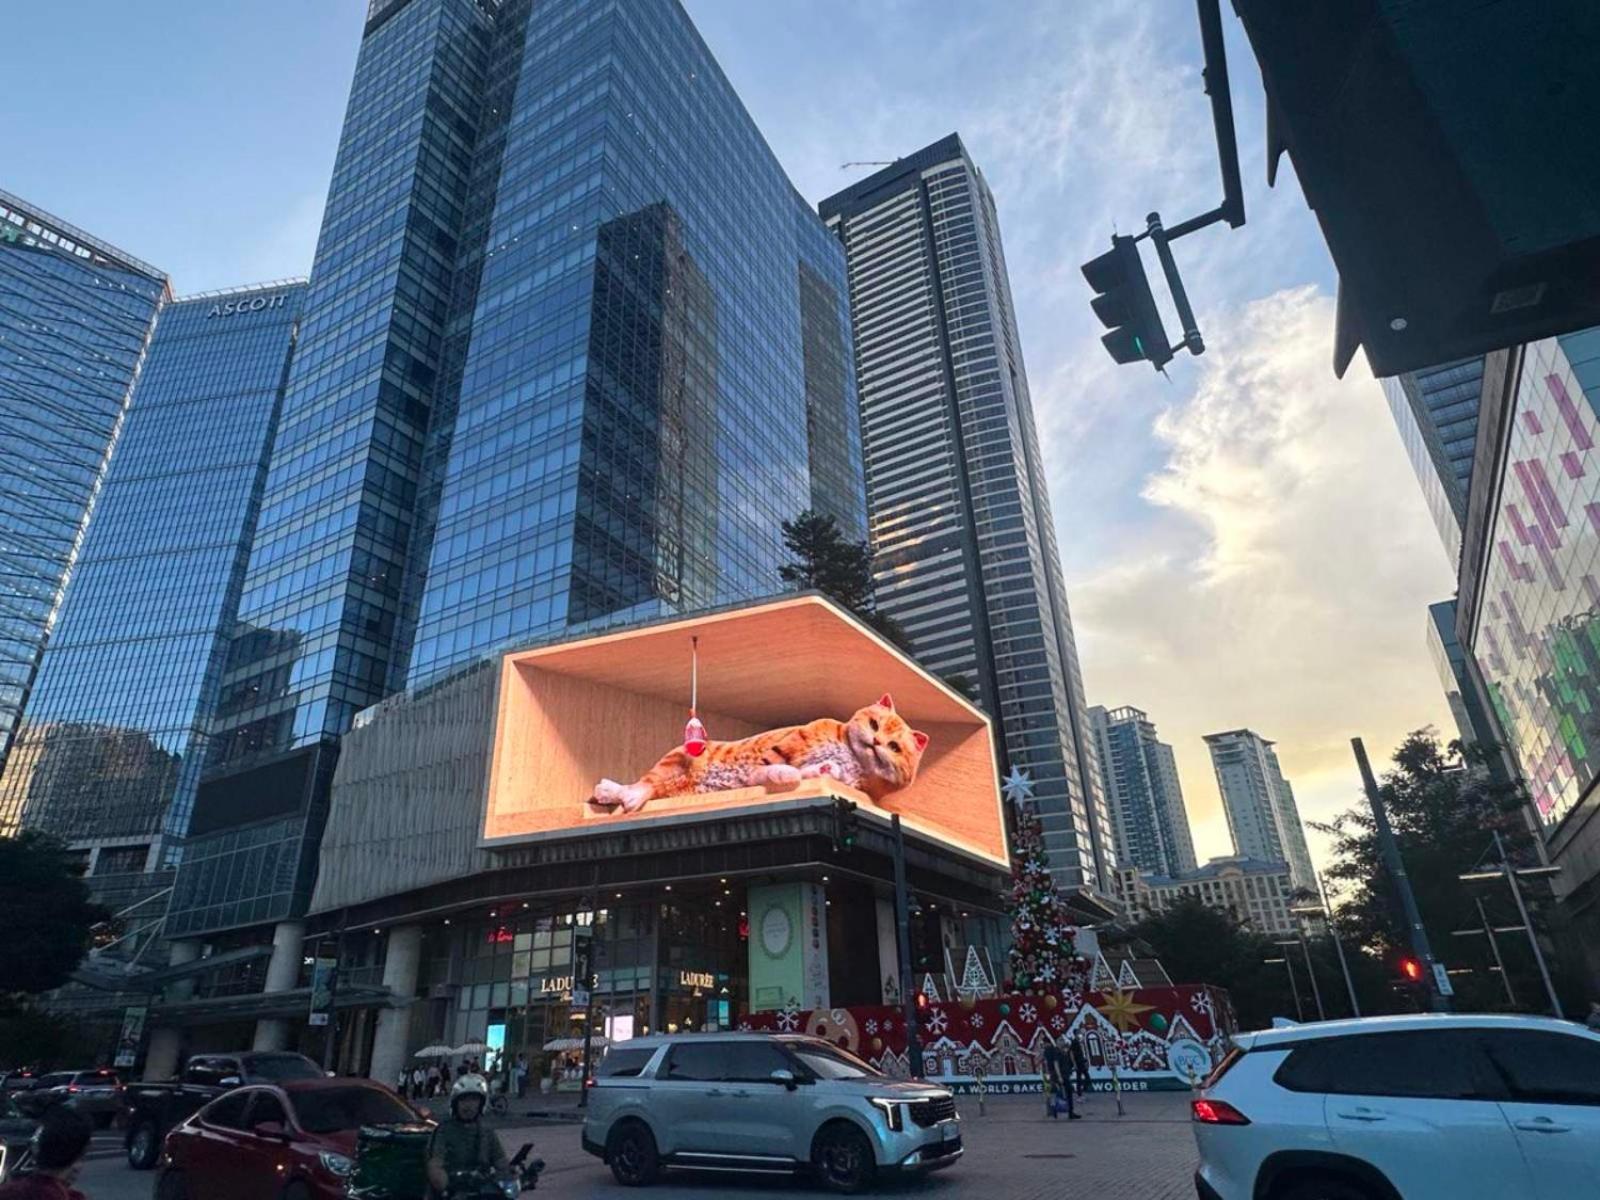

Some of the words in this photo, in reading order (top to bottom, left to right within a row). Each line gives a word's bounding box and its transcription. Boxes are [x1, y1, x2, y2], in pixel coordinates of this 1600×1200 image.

[207, 294, 288, 319] ASCOTT
[541, 974, 599, 993] LADUE
[958, 1086, 965, 1094] A
[969, 1084, 1009, 1094] WORLD
